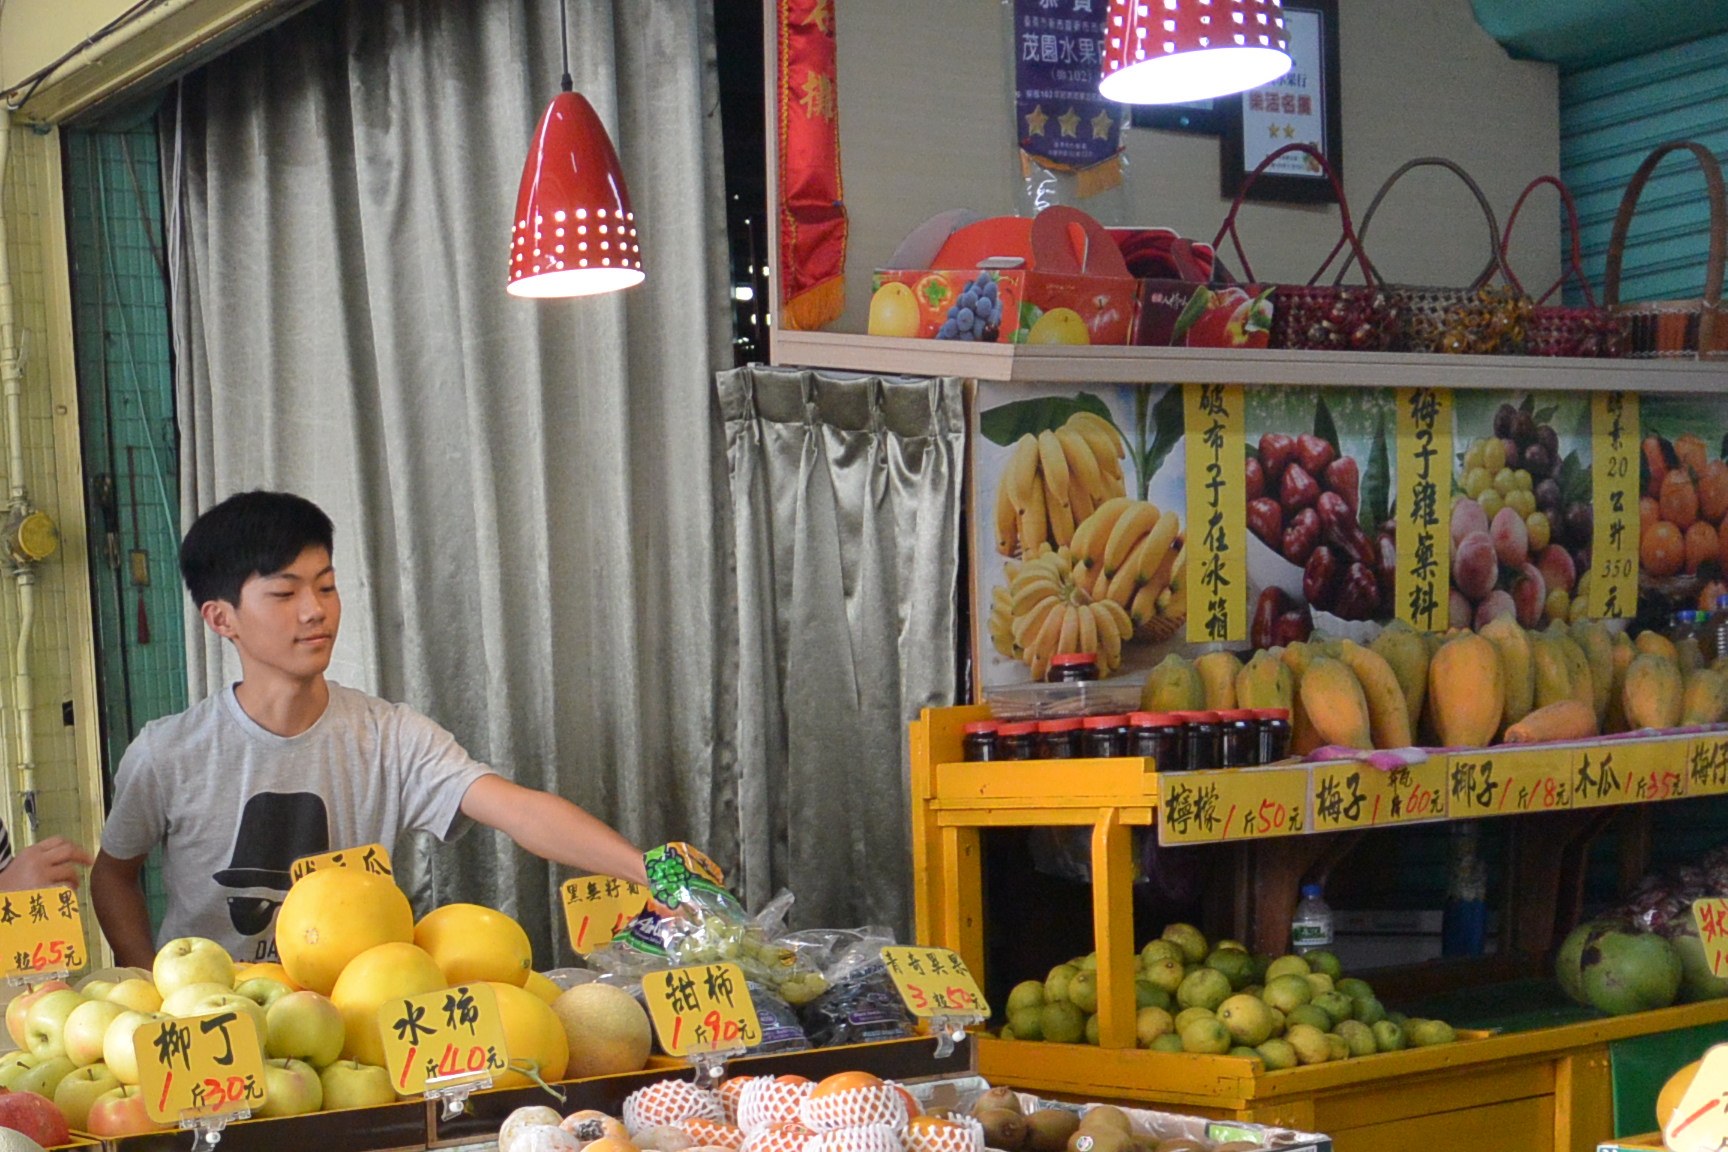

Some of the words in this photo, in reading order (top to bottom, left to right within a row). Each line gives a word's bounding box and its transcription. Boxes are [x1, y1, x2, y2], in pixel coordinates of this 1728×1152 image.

[1022, 32, 1104, 64] 茂園水果
[665, 965, 735, 1015] 甜柿
[153, 1012, 238, 1071] 柳丁
